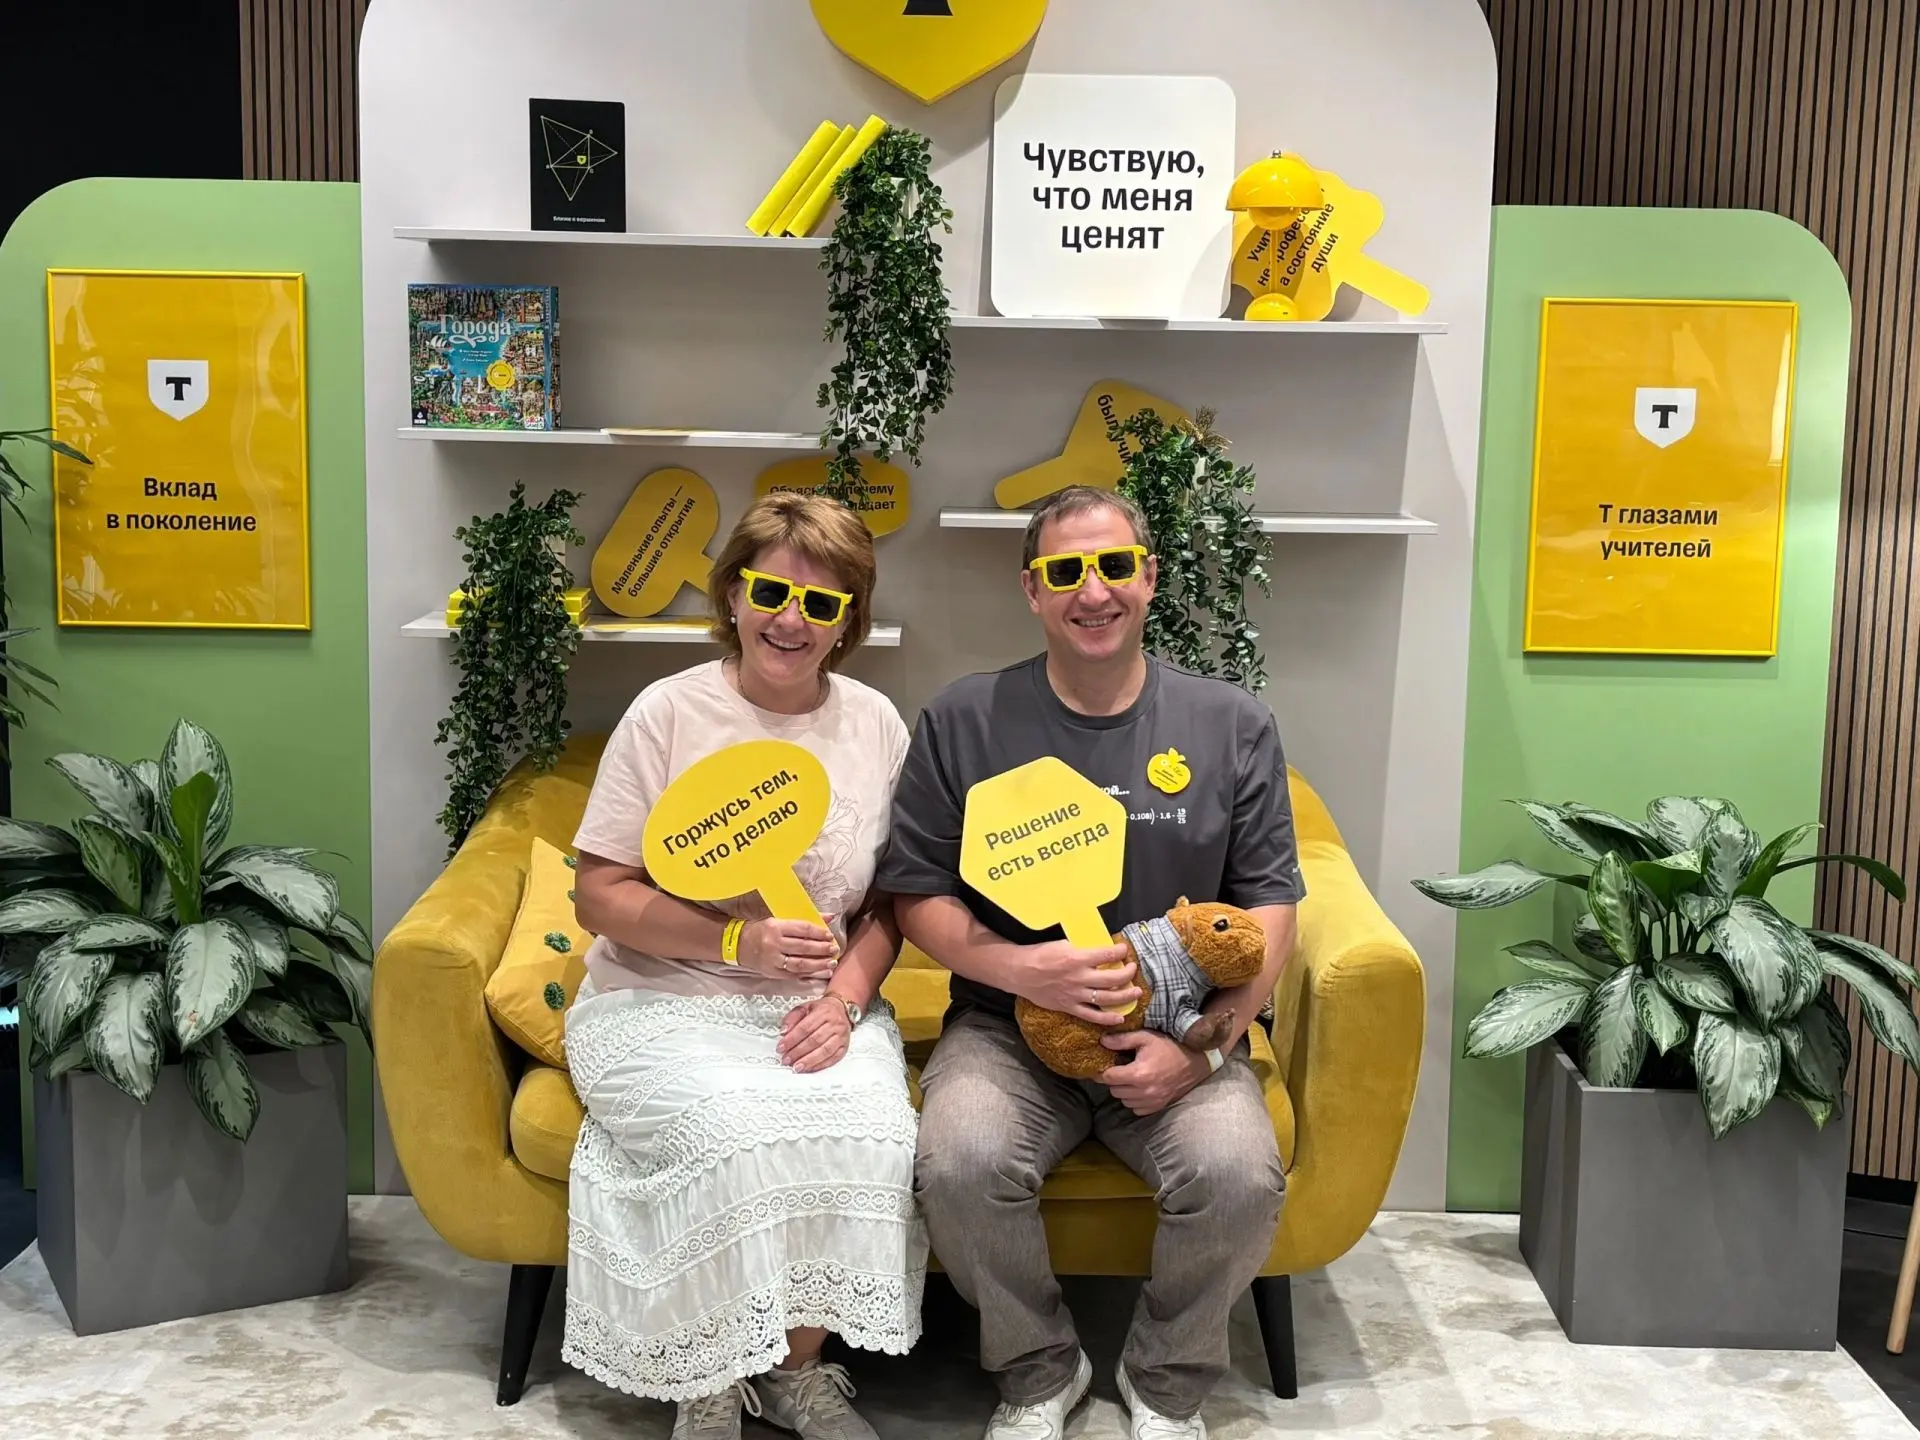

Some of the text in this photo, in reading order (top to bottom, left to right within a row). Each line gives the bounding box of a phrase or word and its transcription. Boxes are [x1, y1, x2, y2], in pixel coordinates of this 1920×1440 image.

[1024, 143, 1204, 179] Чувствую,
[1033, 187, 1192, 211] что меня
[1062, 226, 1164, 252] ценят
[1280, 203, 1334, 286] а состояние
[1311, 233, 1339, 273] души
[143, 477, 218, 501] Вклад
[107, 513, 257, 531] в поколение
[1599, 504, 1718, 525] Т глазами
[611, 533, 654, 594] Маленькие
[651, 498, 678, 533] опыты
[628, 498, 696, 597] большие открытия
[1601, 539, 1711, 560] учителей
[663, 770, 798, 855] Горжусь тем,
[985, 803, 1081, 850] Решение
[694, 800, 798, 868] что делаю
[988, 822, 1109, 881] есть всегда
